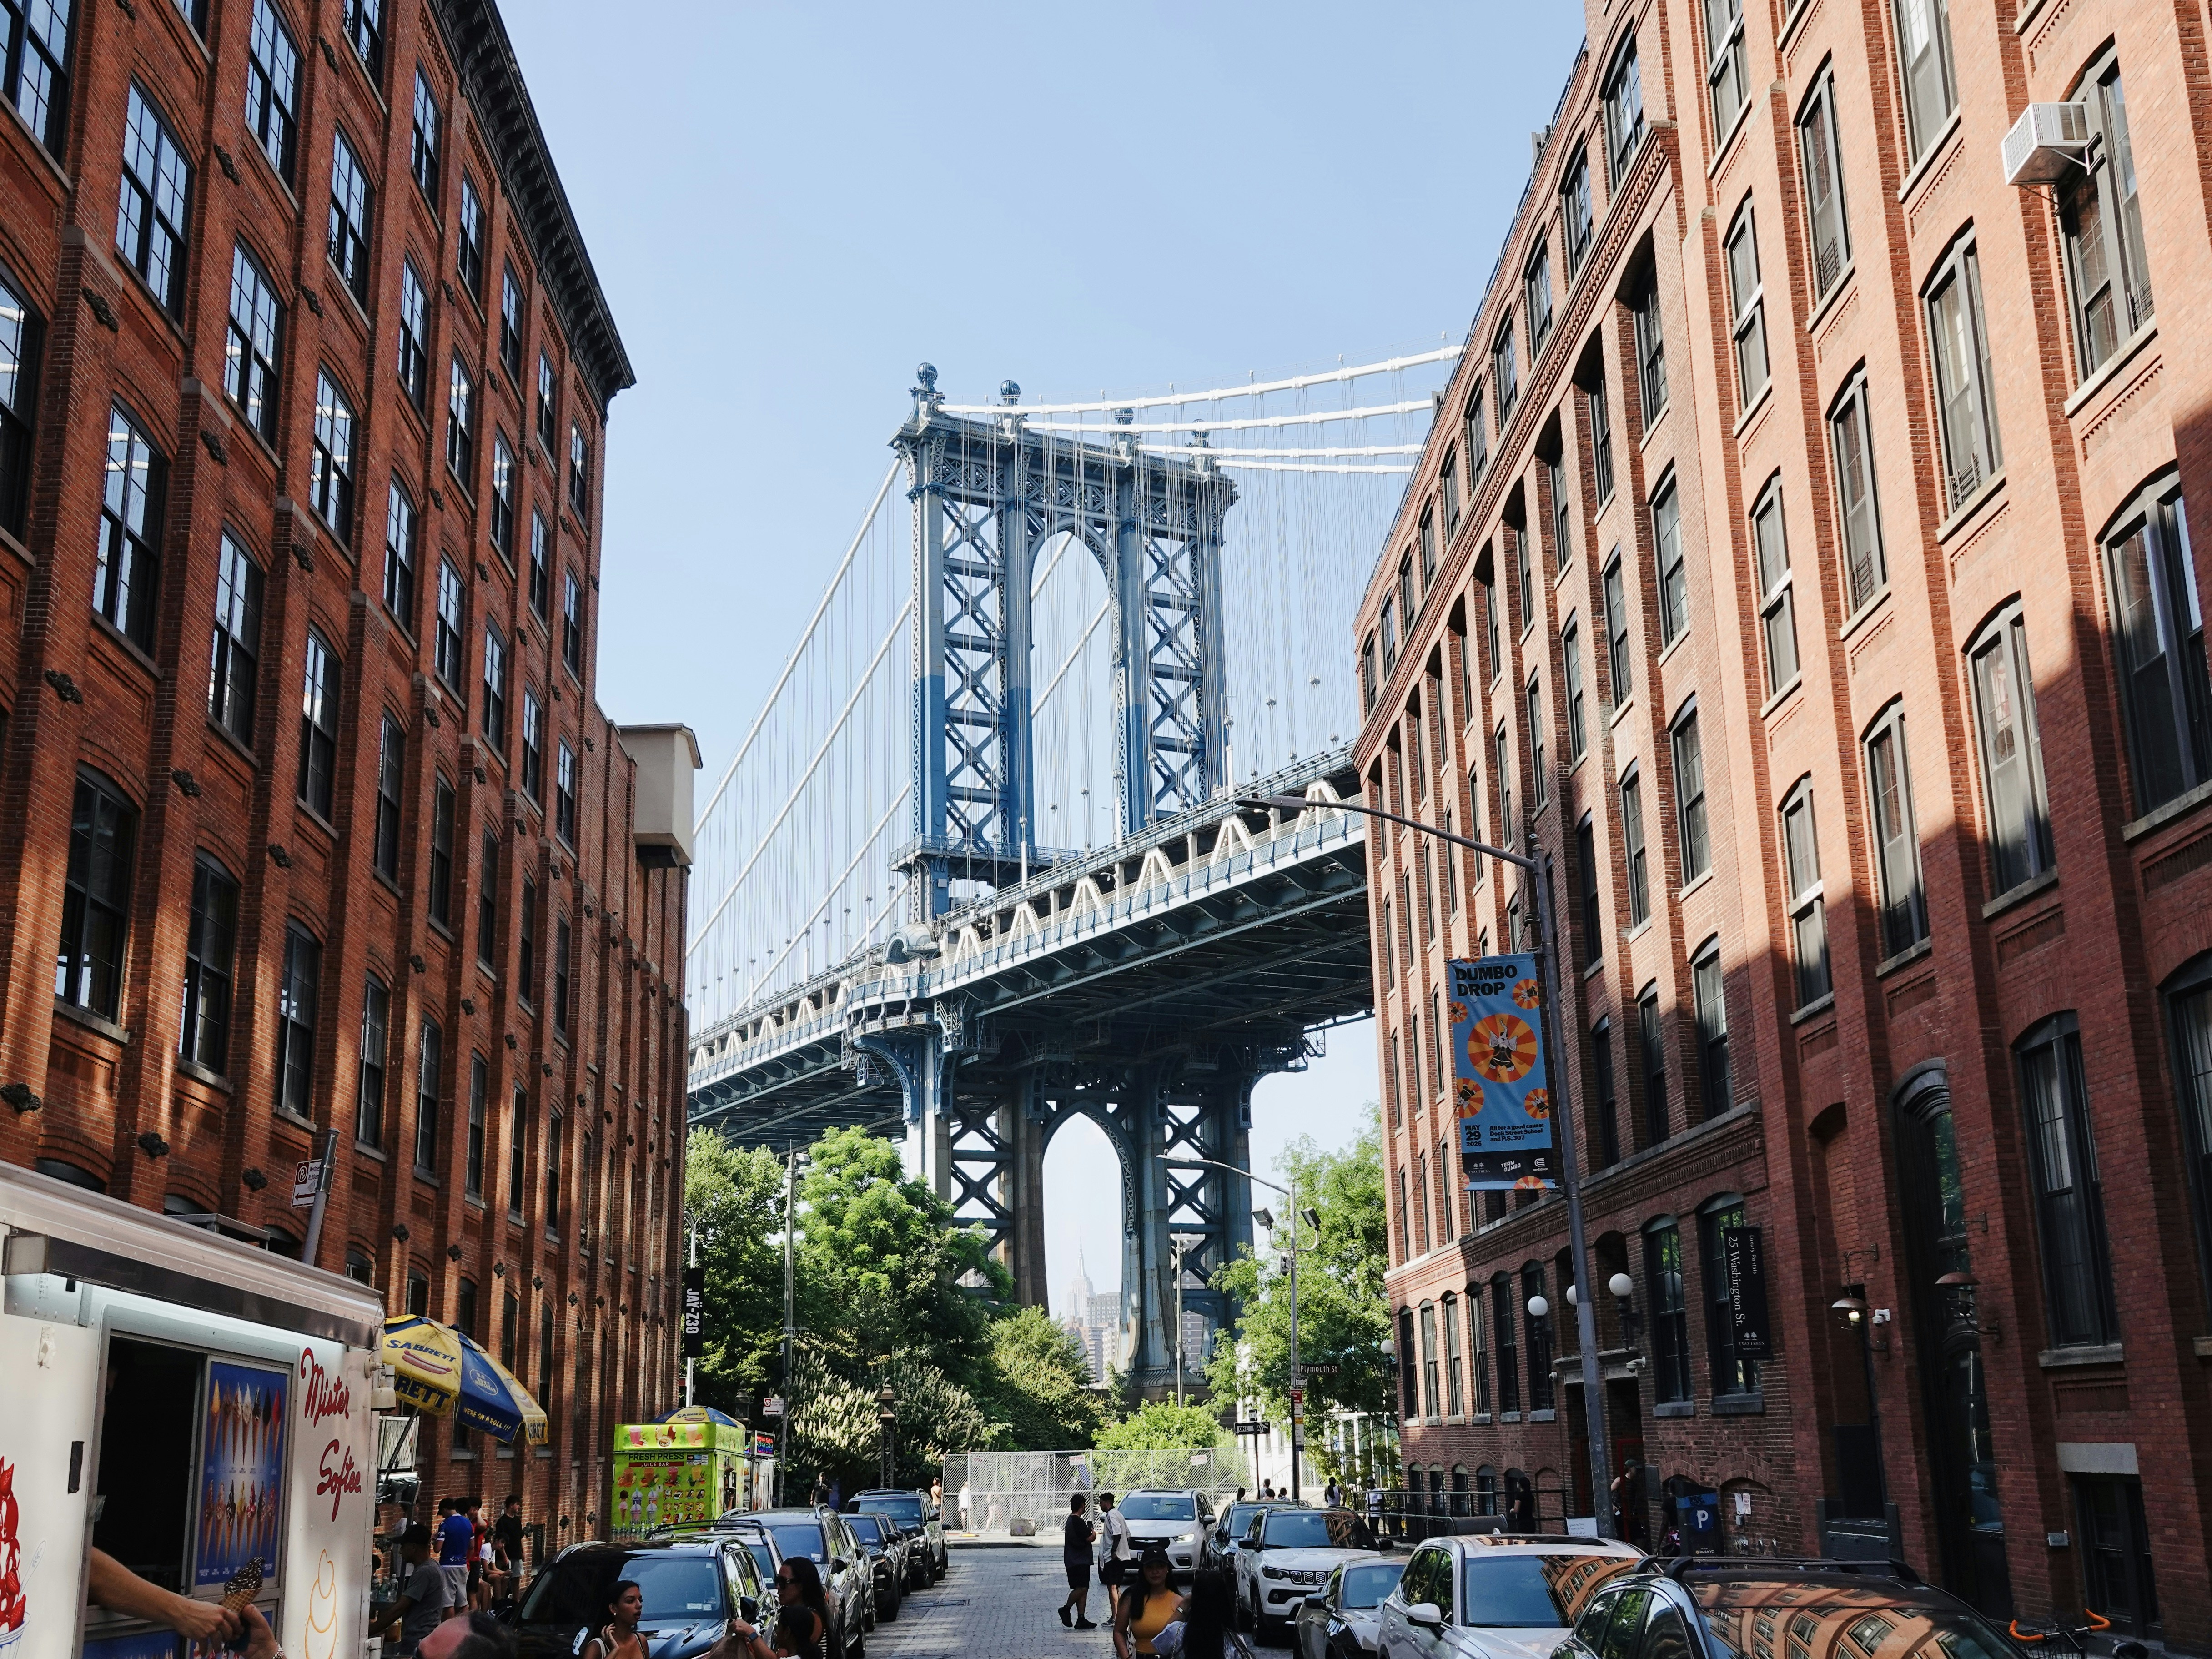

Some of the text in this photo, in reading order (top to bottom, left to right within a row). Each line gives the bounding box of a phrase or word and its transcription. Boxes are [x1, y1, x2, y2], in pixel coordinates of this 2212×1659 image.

[1455, 965, 1518, 981] DUMBO
[1457, 982, 1506, 996] DROP
[1466, 1131, 1481, 1141] 29
[1504, 1163, 1521, 1172] DUMBO
[1728, 1235, 1745, 1327] 25 Washington St.
[386, 1339, 457, 1362] SABRETT
[1301, 1365, 1330, 1374] Plymouth
[300, 1347, 350, 1428] Mister
[394, 1374, 452, 1408] RETT
[490, 1418, 503, 1428] ROLL
[317, 1439, 361, 1522] Softee
[1696, 1510, 1709, 1528] P
